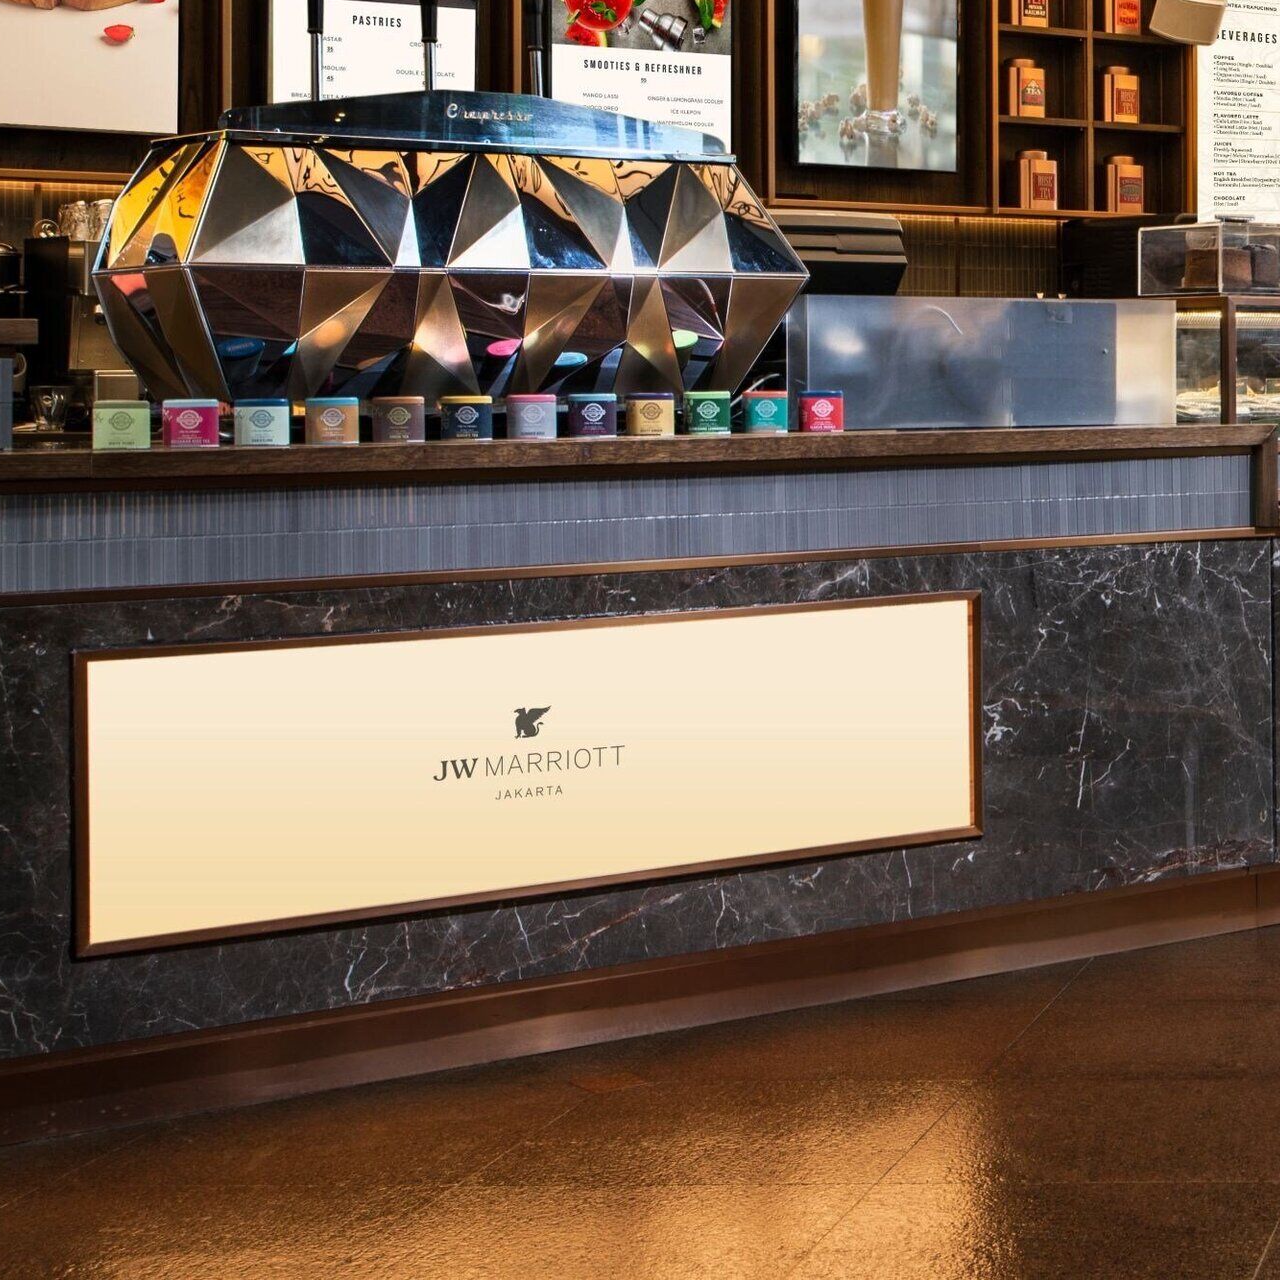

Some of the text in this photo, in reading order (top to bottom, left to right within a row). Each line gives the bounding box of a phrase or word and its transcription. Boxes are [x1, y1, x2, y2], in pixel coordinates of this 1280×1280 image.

[352, 15, 403, 29] PASTRIES
[1217, 29, 1278, 46] EVERAGES
[583, 59, 703, 75] SMOOTIES & REFRESHNER
[432, 744, 626, 782] JW MARRIOTT
[494, 784, 564, 801] JAKARTA
